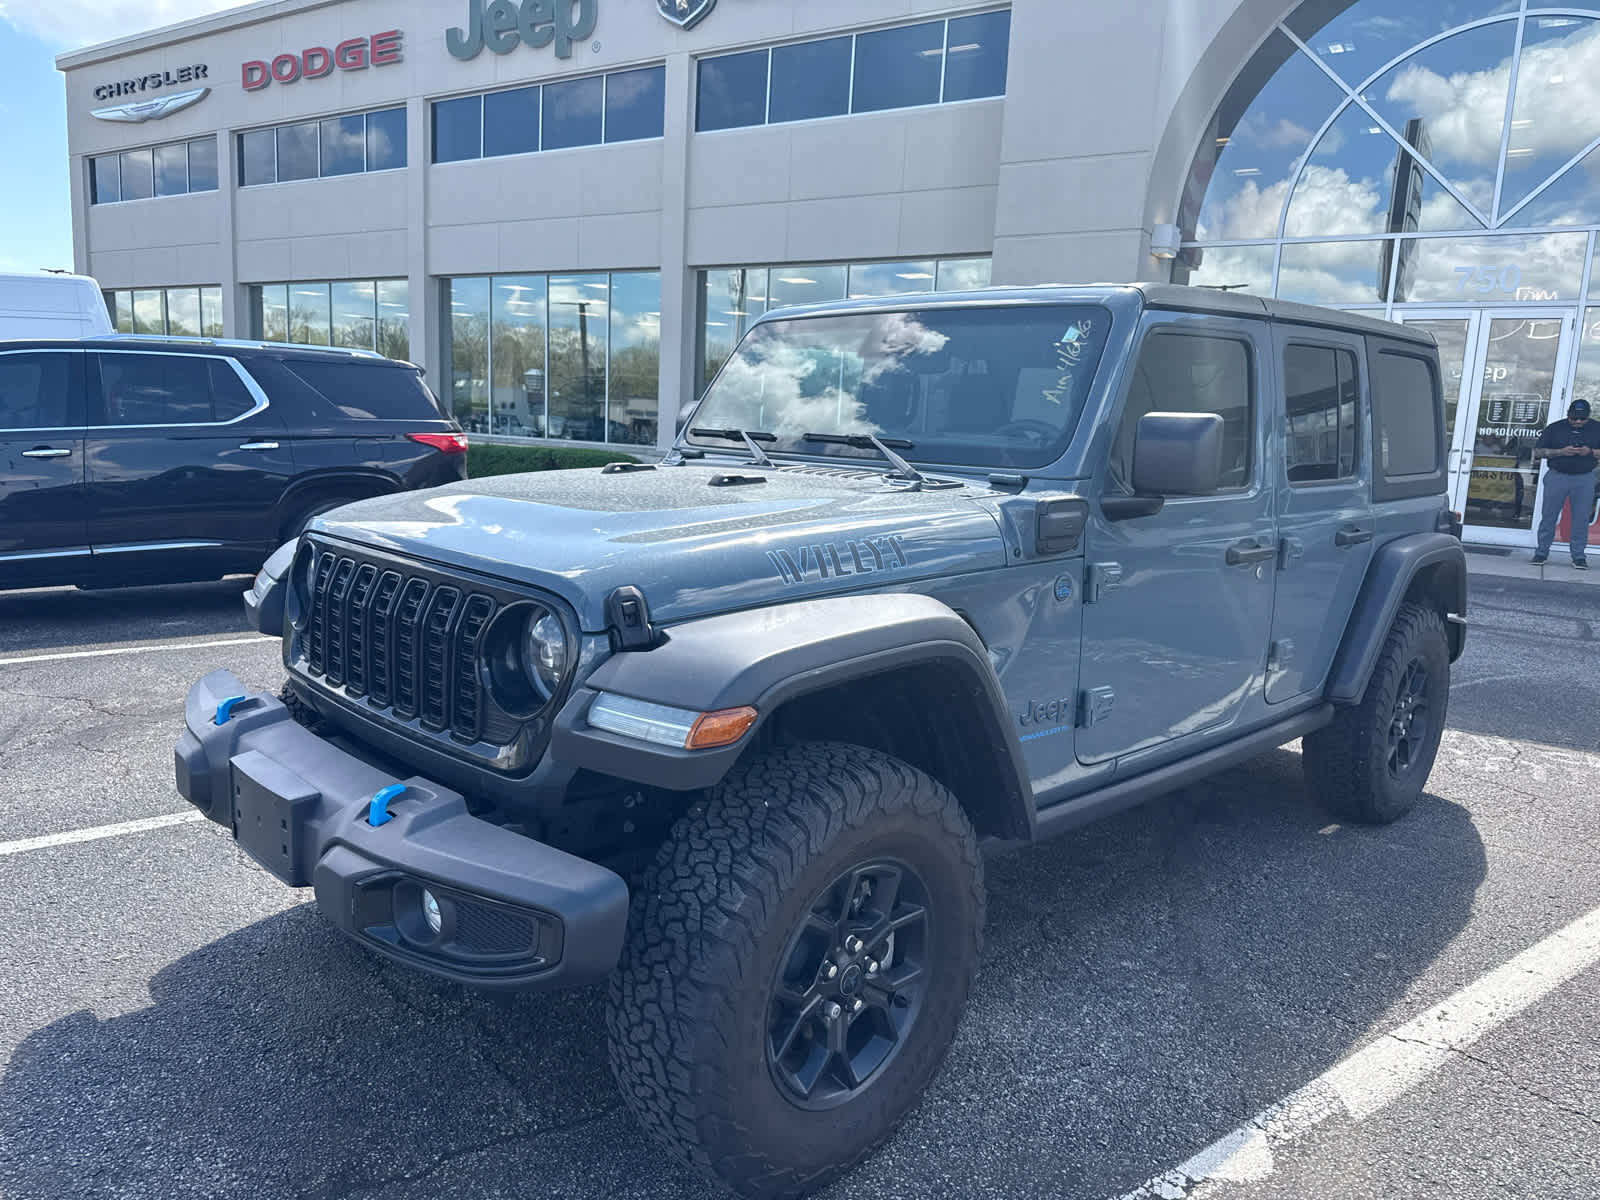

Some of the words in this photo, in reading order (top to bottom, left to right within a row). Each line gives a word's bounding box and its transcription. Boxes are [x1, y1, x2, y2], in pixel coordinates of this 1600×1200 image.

[446, 0, 598, 60] Jeep
[241, 29, 404, 91] DODGE
[94, 64, 209, 101] CHRYSLER
[1454, 264, 1521, 293] 750
[1479, 427, 1492, 436] NO
[1495, 428, 1543, 437] SOLICITING
[766, 535, 906, 585] WILLYS
[1020, 698, 1069, 726] Jeep
